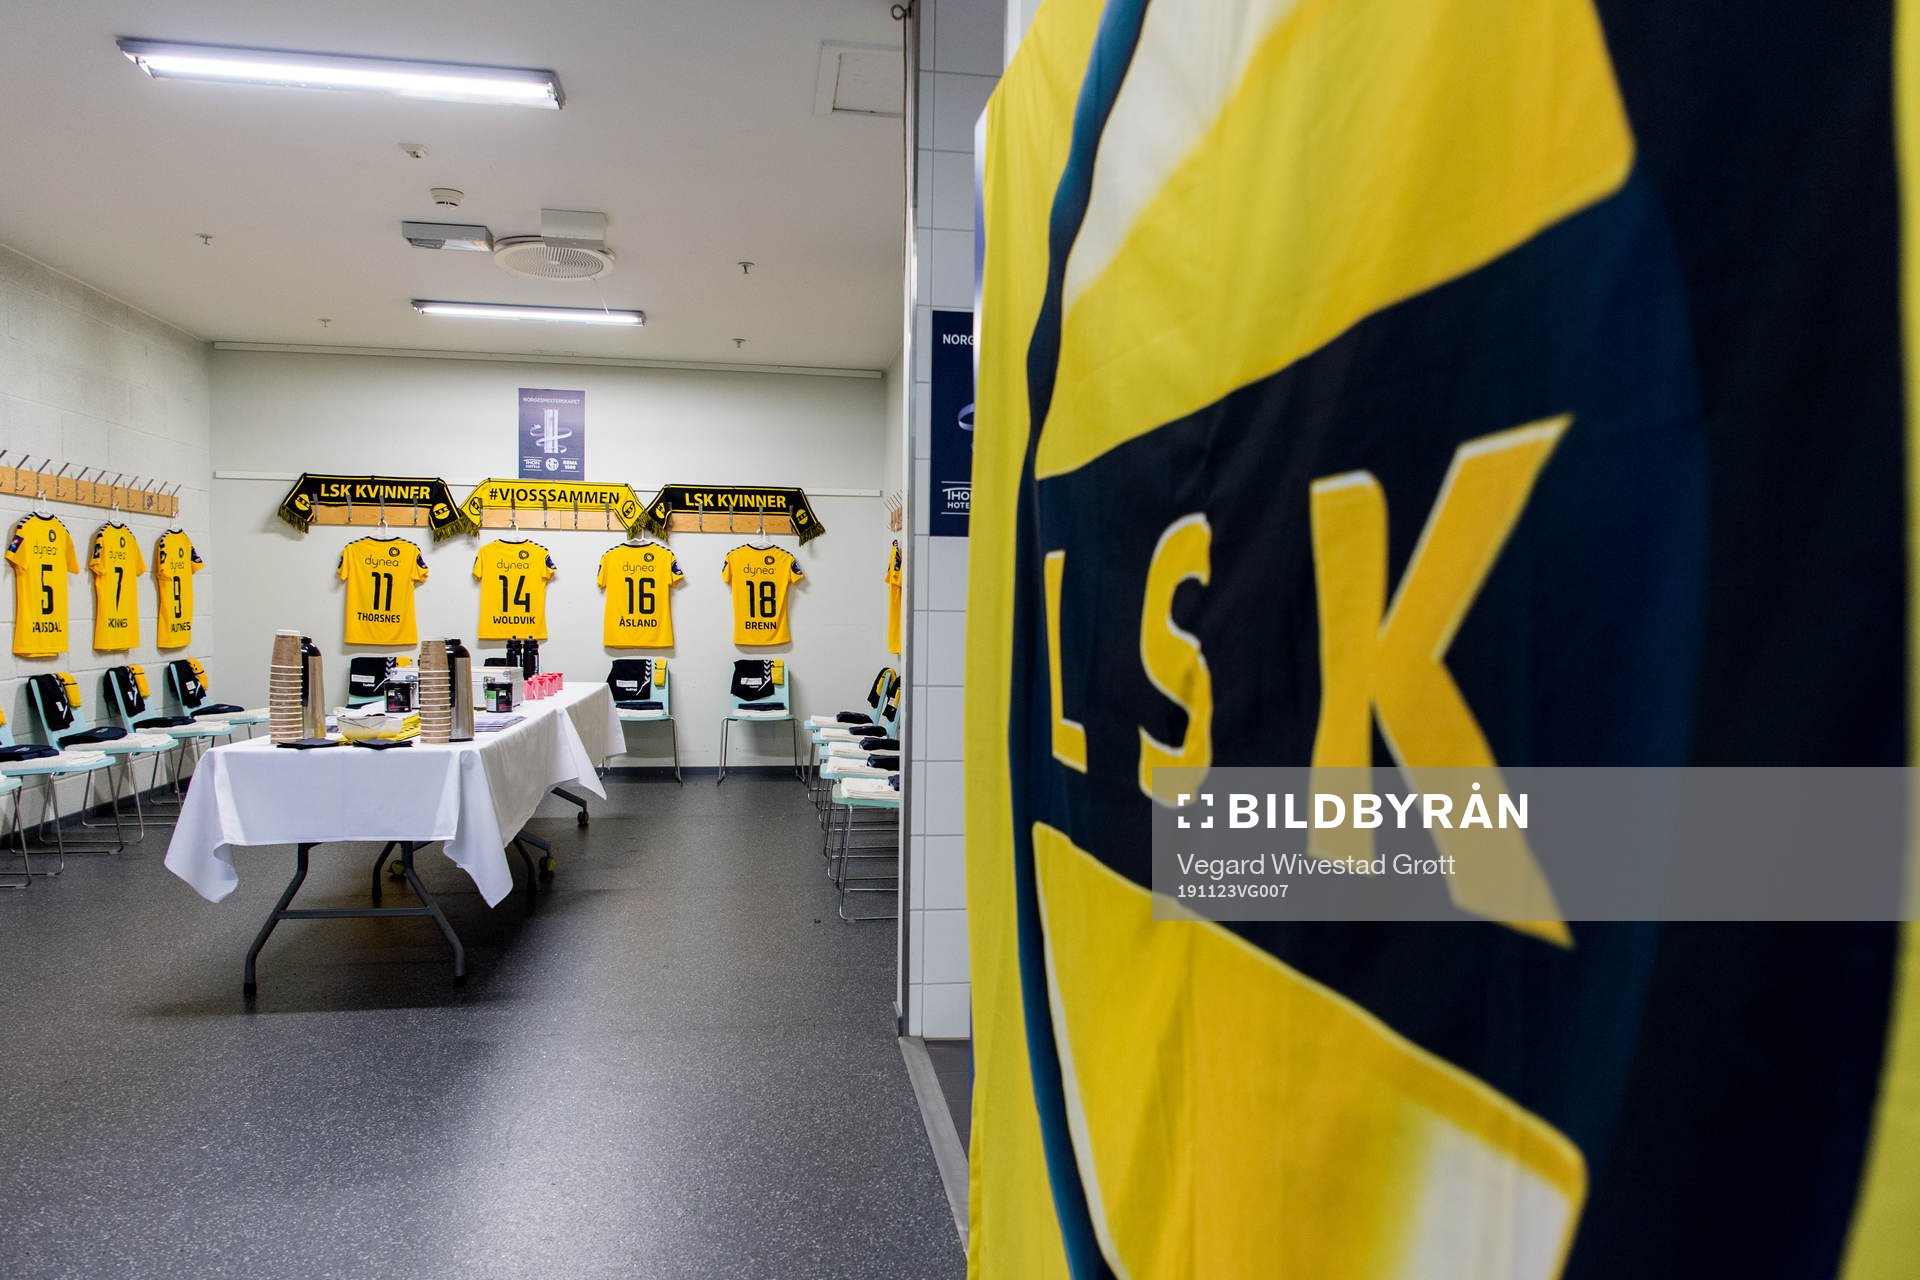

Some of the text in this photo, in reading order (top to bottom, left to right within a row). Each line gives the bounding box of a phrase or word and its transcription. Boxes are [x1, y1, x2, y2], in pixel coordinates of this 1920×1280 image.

[321, 483, 430, 500] LSK KVINNER
[489, 488, 620, 504] #VIOSSSAMMEN
[685, 493, 786, 508] LSK KVINNER
[364, 555, 399, 568] dynea
[496, 558, 529, 572] dynea
[622, 561, 654, 574] dynea
[743, 563, 775, 577] dynea
[41, 564, 54, 615] 5
[114, 567, 124, 611] 7
[173, 576, 181, 618] 9
[371, 571, 393, 611] 11
[498, 575, 530, 613] 14
[625, 577, 655, 614] 16
[745, 580, 776, 618] 18
[357, 612, 401, 623] THORSNES
[493, 615, 536, 624] WOLDVIK
[619, 616, 657, 627] ÅSLAND
[745, 621, 777, 630] BRENN
[1044, 411, 1575, 949] LSK
